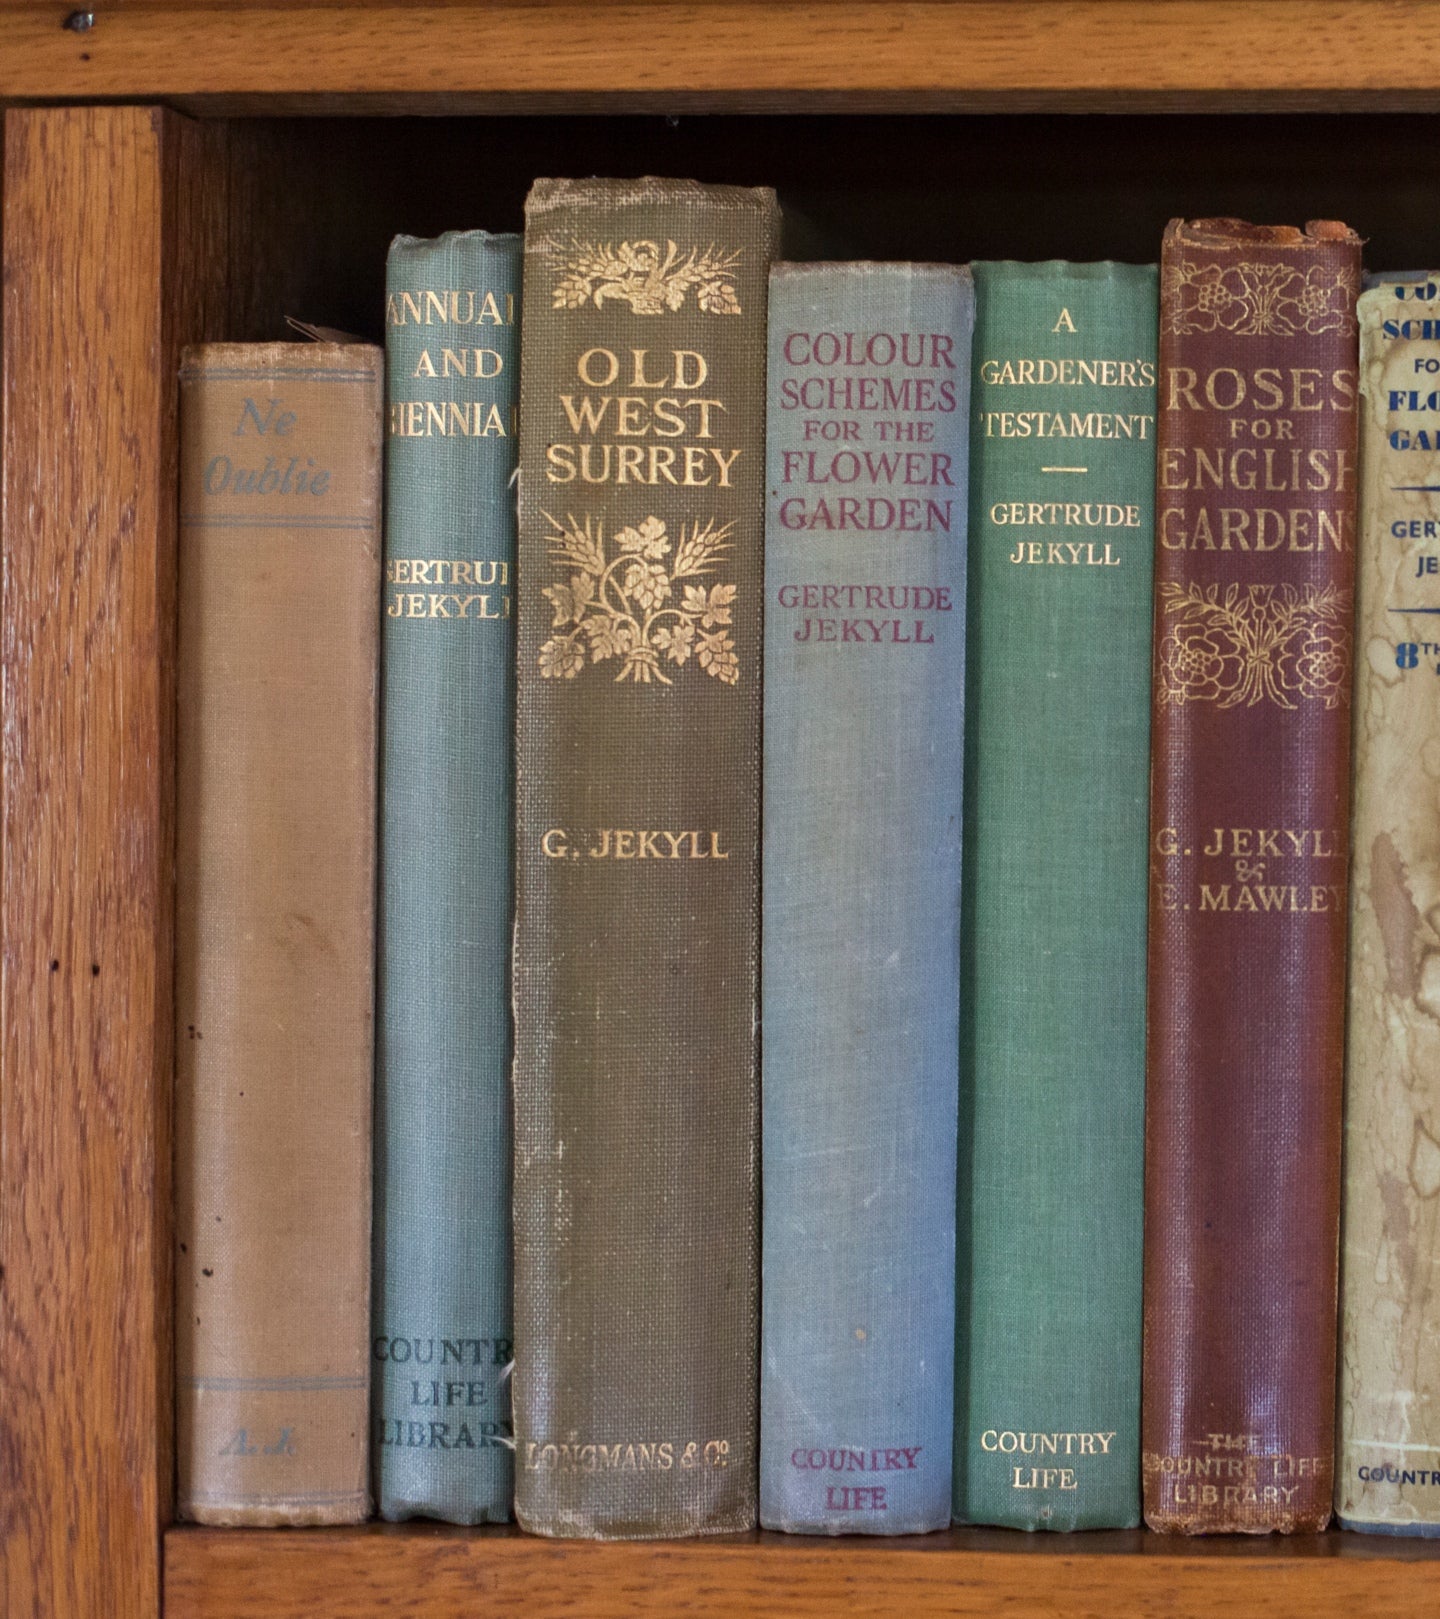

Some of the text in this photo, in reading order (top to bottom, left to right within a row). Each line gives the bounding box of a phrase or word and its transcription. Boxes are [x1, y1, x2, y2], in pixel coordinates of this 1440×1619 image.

[1051, 307, 1078, 334] A
[413, 349, 504, 378] AND
[784, 332, 956, 369] COLOUR
[578, 348, 708, 389] OLD
[980, 359, 1156, 387] GARDENER'S
[780, 377, 957, 412] SCHEMES
[1166, 367, 1355, 412] ROSES
[233, 397, 298, 437] Ne
[389, 401, 518, 438] IENNIA
[559, 395, 729, 438] WEST
[980, 411, 1154, 440] TESTAMENT
[1229, 418, 1296, 440] FOR
[803, 420, 935, 443] FOR THE
[204, 455, 332, 496] Oublie
[546, 443, 742, 487] SURREY
[781, 451, 955, 486] FLOWER
[779, 498, 954, 532] GARDEN
[990, 503, 1141, 527] GERTRUDE
[1010, 542, 1121, 565] JEKYLL
[777, 585, 953, 611] GERTRUDE
[794, 618, 935, 644] JEKYLL
[541, 829, 728, 860] G. JEKYLL
[1156, 827, 1192, 857] G.
[1235, 859, 1266, 883] &
[1157, 883, 1190, 911] E.
[373, 1337, 513, 1366] COUNTR
[411, 1381, 488, 1406] LIFE
[525, 1442, 674, 1471] LONGMANS
[680, 1441, 698, 1468] &
[981, 1430, 1116, 1455] COUNTRY
[1207, 1433, 1263, 1452] THE
[791, 1447, 922, 1473] COUNTRY
[1012, 1467, 1078, 1490] LIFE
[825, 1486, 888, 1511] LIFE
[1174, 1484, 1300, 1506] LIBRARY
